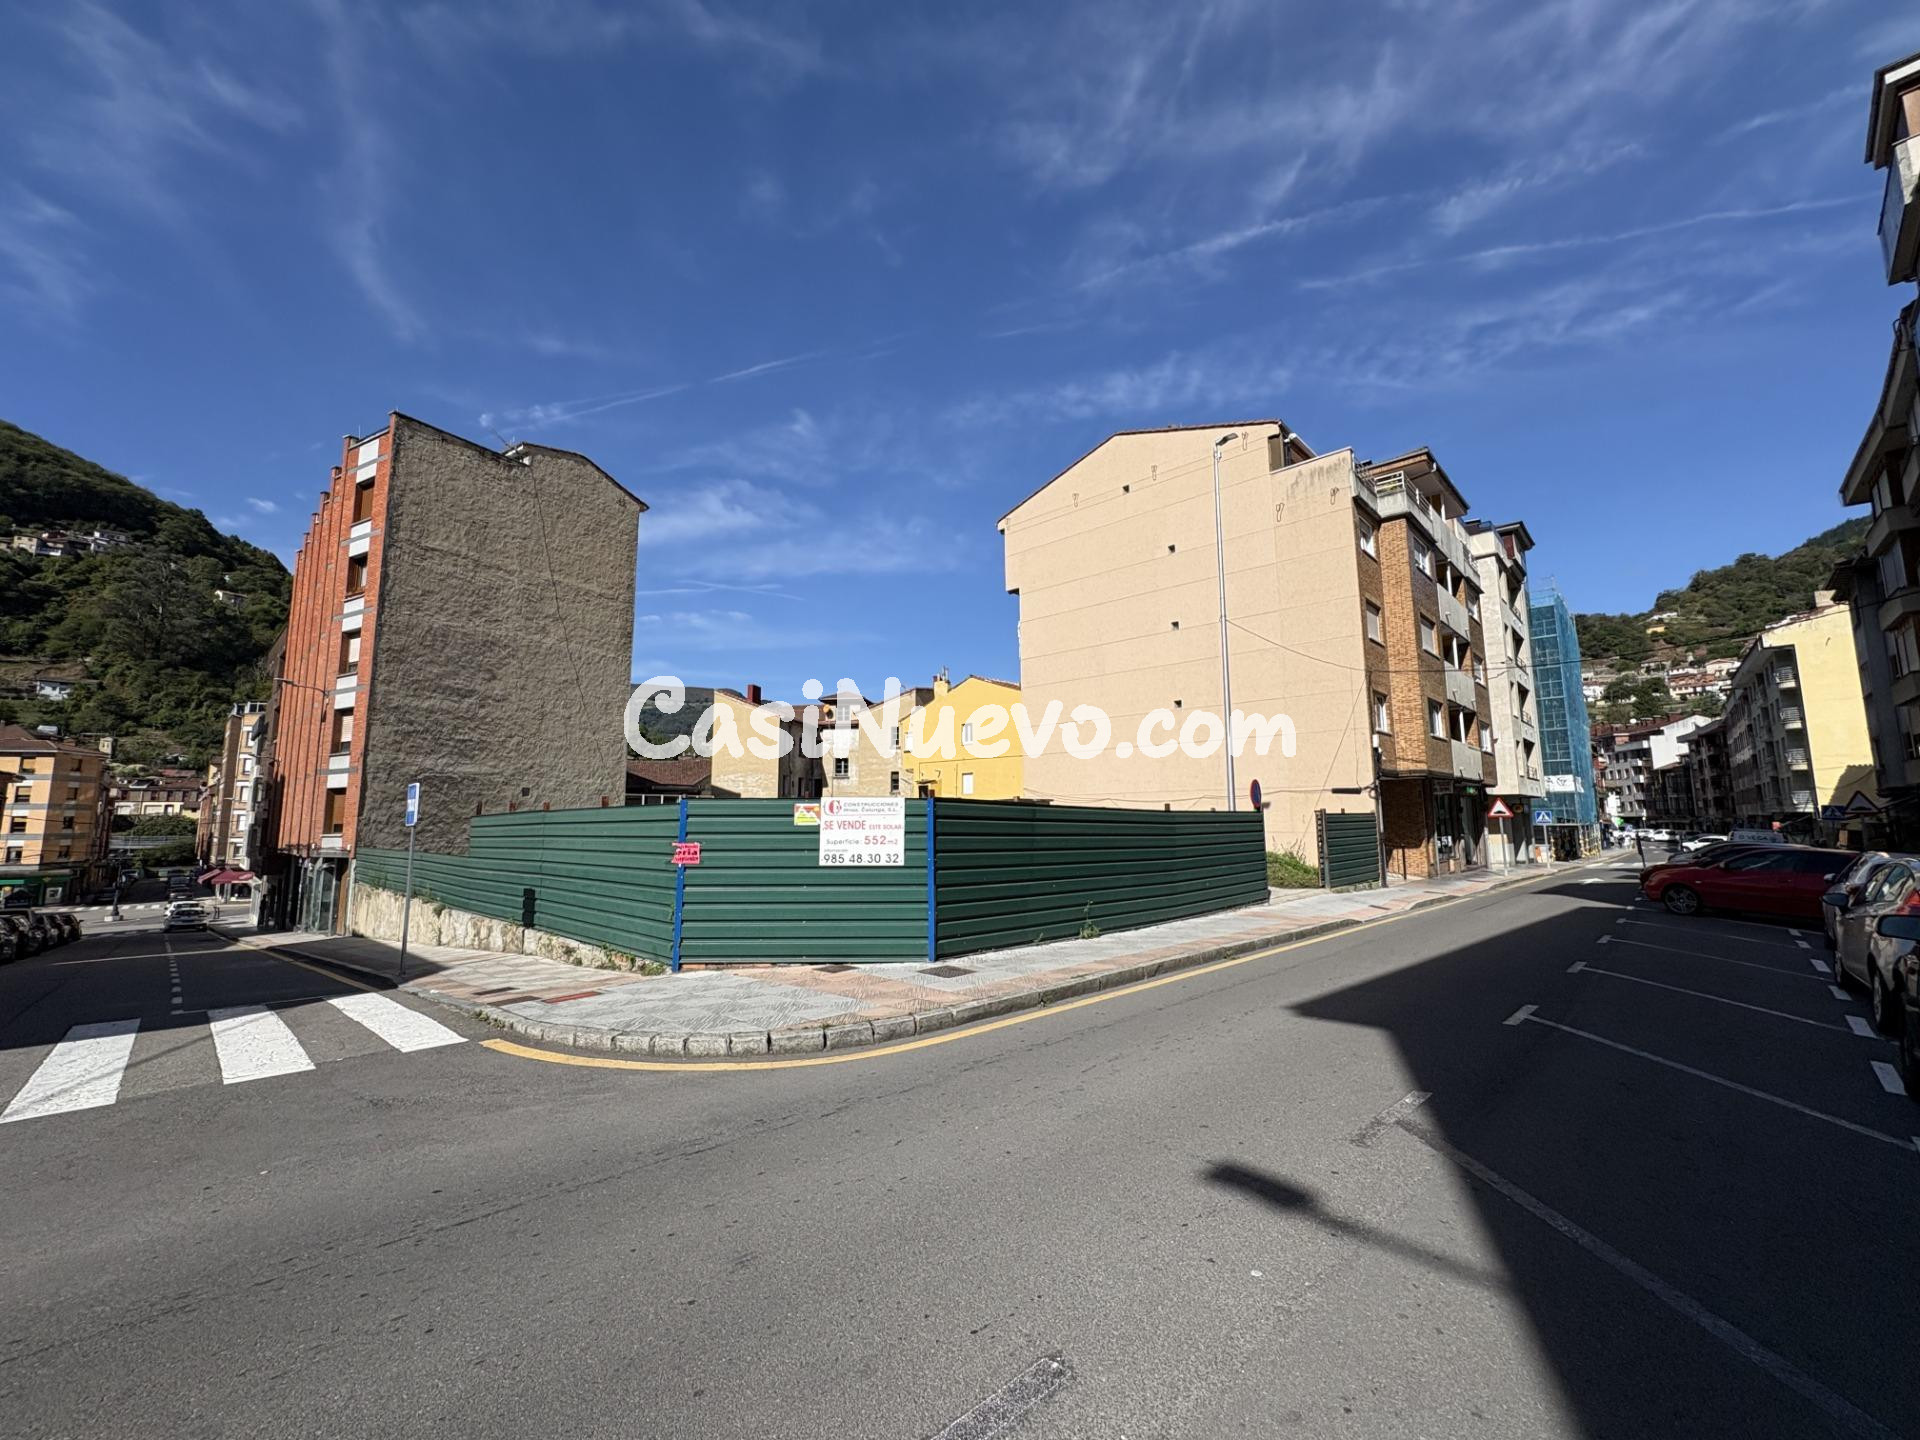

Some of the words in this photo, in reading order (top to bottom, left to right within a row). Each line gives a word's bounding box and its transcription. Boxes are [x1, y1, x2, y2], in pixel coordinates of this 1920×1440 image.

[824, 820, 834, 830] SE
[837, 820, 867, 830] VENDE
[864, 835, 887, 845] 552
[823, 853, 845, 864] 985
[885, 853, 899, 864] 32
